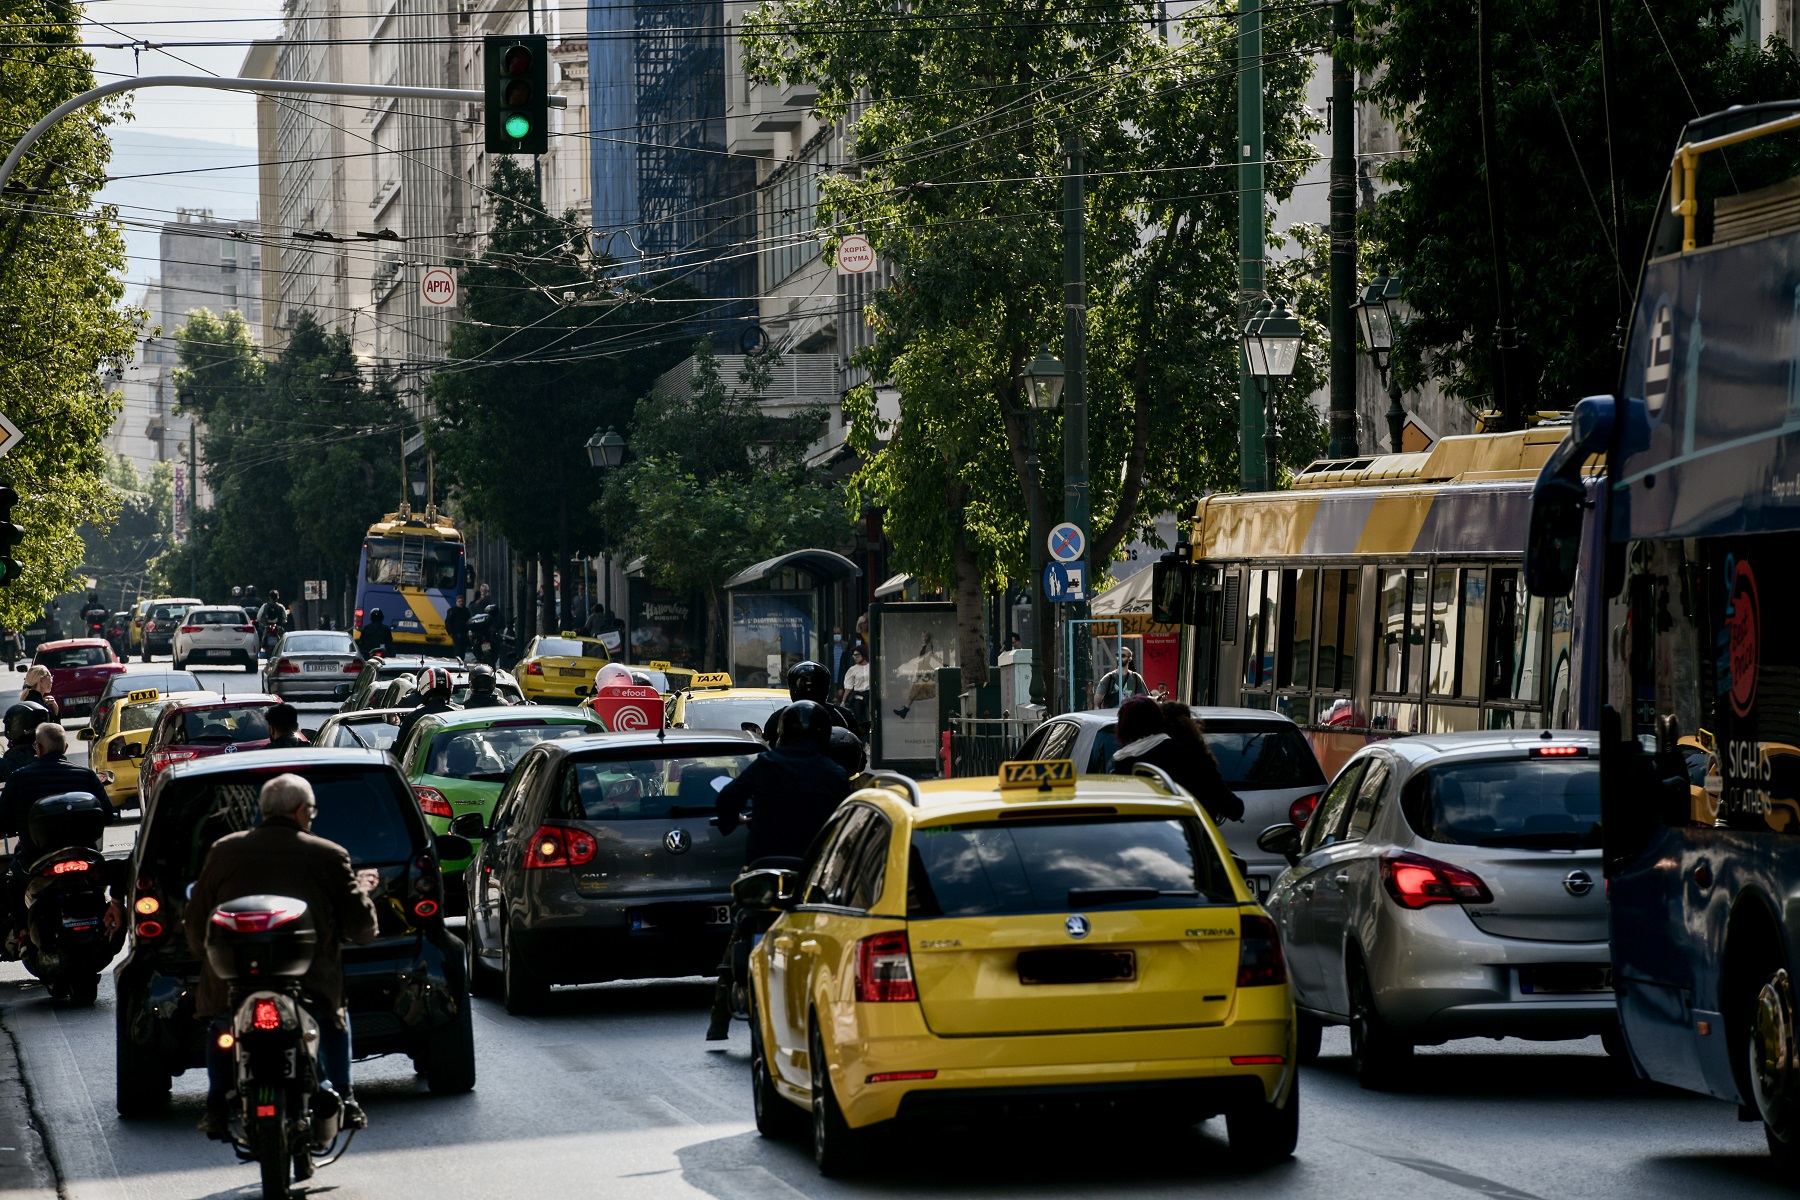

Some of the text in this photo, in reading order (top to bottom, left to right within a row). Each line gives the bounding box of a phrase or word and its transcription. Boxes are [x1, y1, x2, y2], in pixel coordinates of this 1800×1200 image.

[427, 280, 451, 293] ΑΡΓΑ
[697, 675, 724, 683] TAXI
[132, 690, 155, 699] TAXI
[622, 689, 646, 697] efood
[1729, 739, 1771, 781] SIGHTS
[1008, 763, 1069, 781] TAXI
